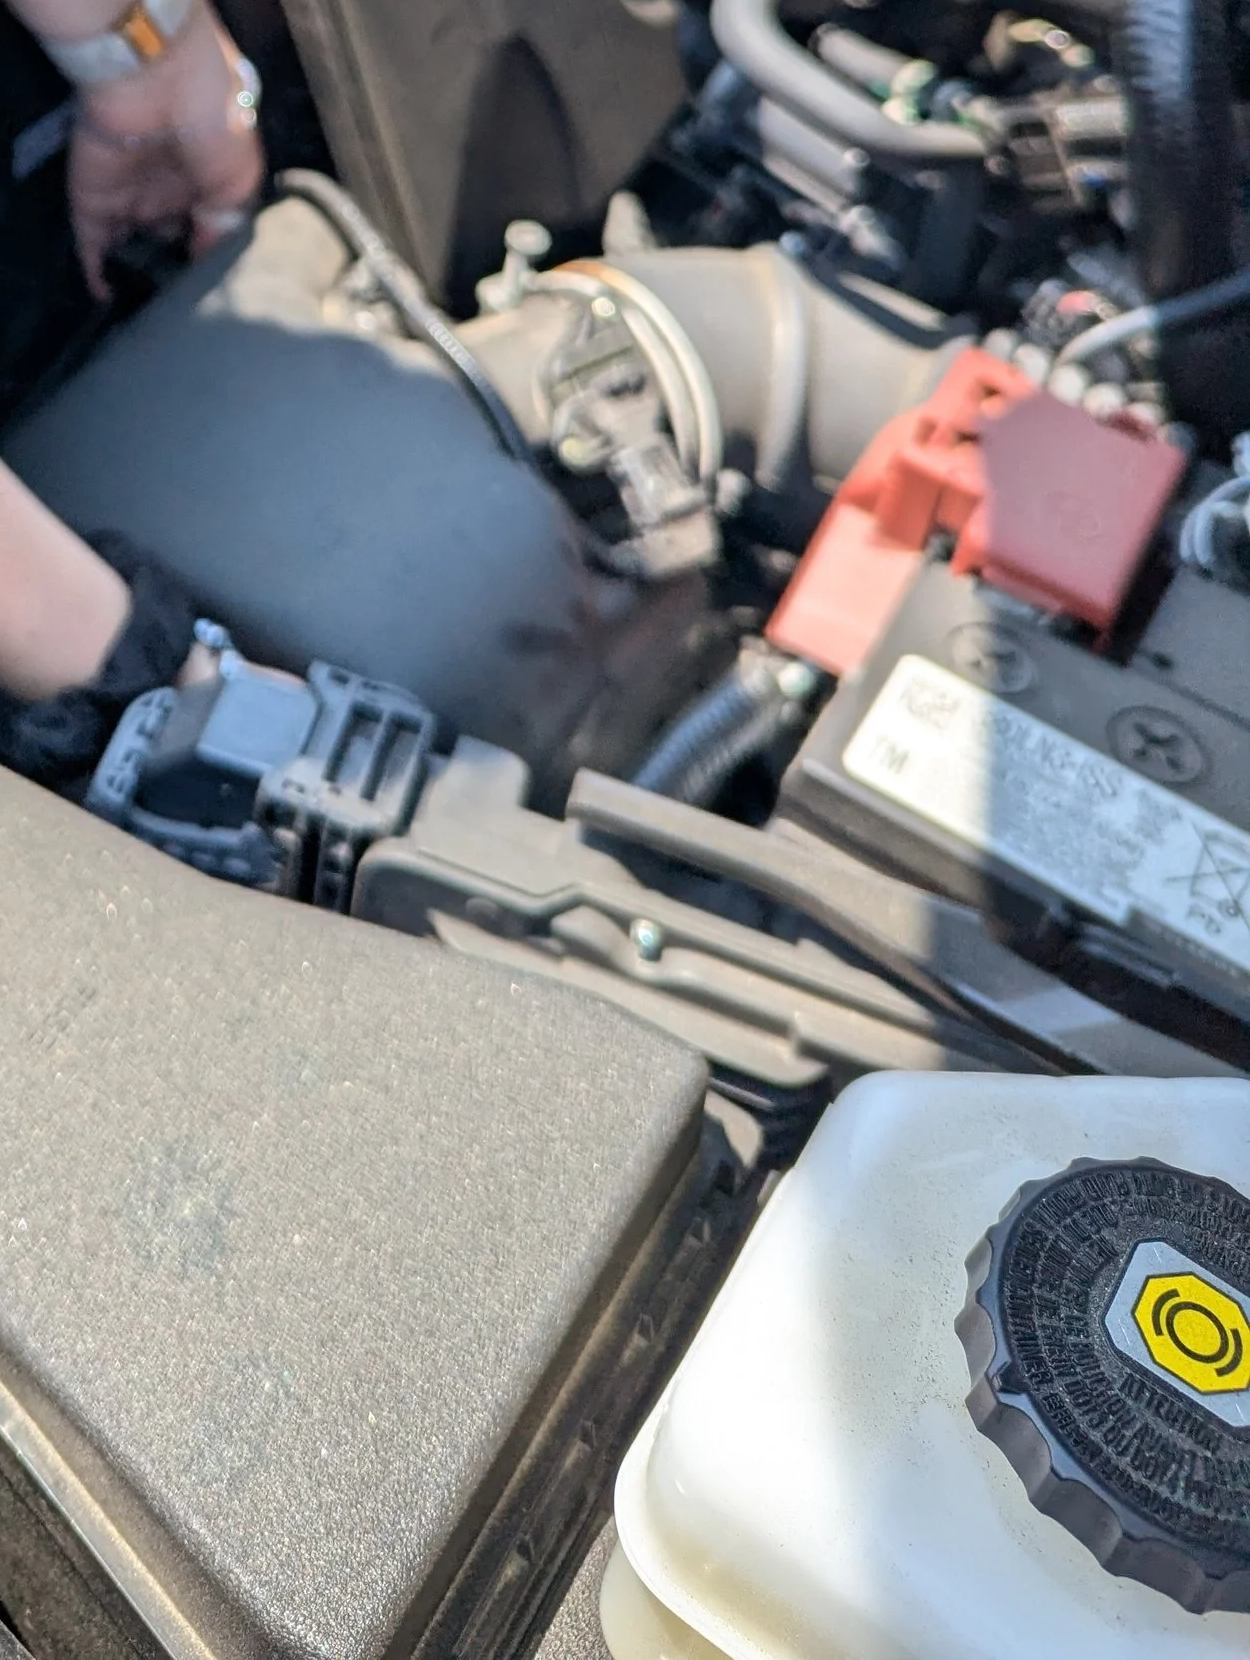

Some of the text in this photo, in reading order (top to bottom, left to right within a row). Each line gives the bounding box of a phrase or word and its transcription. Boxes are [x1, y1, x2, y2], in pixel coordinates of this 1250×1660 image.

[1037, 1181, 1089, 1223] FROM
[1076, 1203, 1121, 1237] QUE
[1007, 1217, 1049, 1284] SEALED
[1034, 1292, 1063, 1323] DE
[1036, 1321, 1080, 1377] FREIN
[1066, 1338, 1139, 1434] BOUCHON
